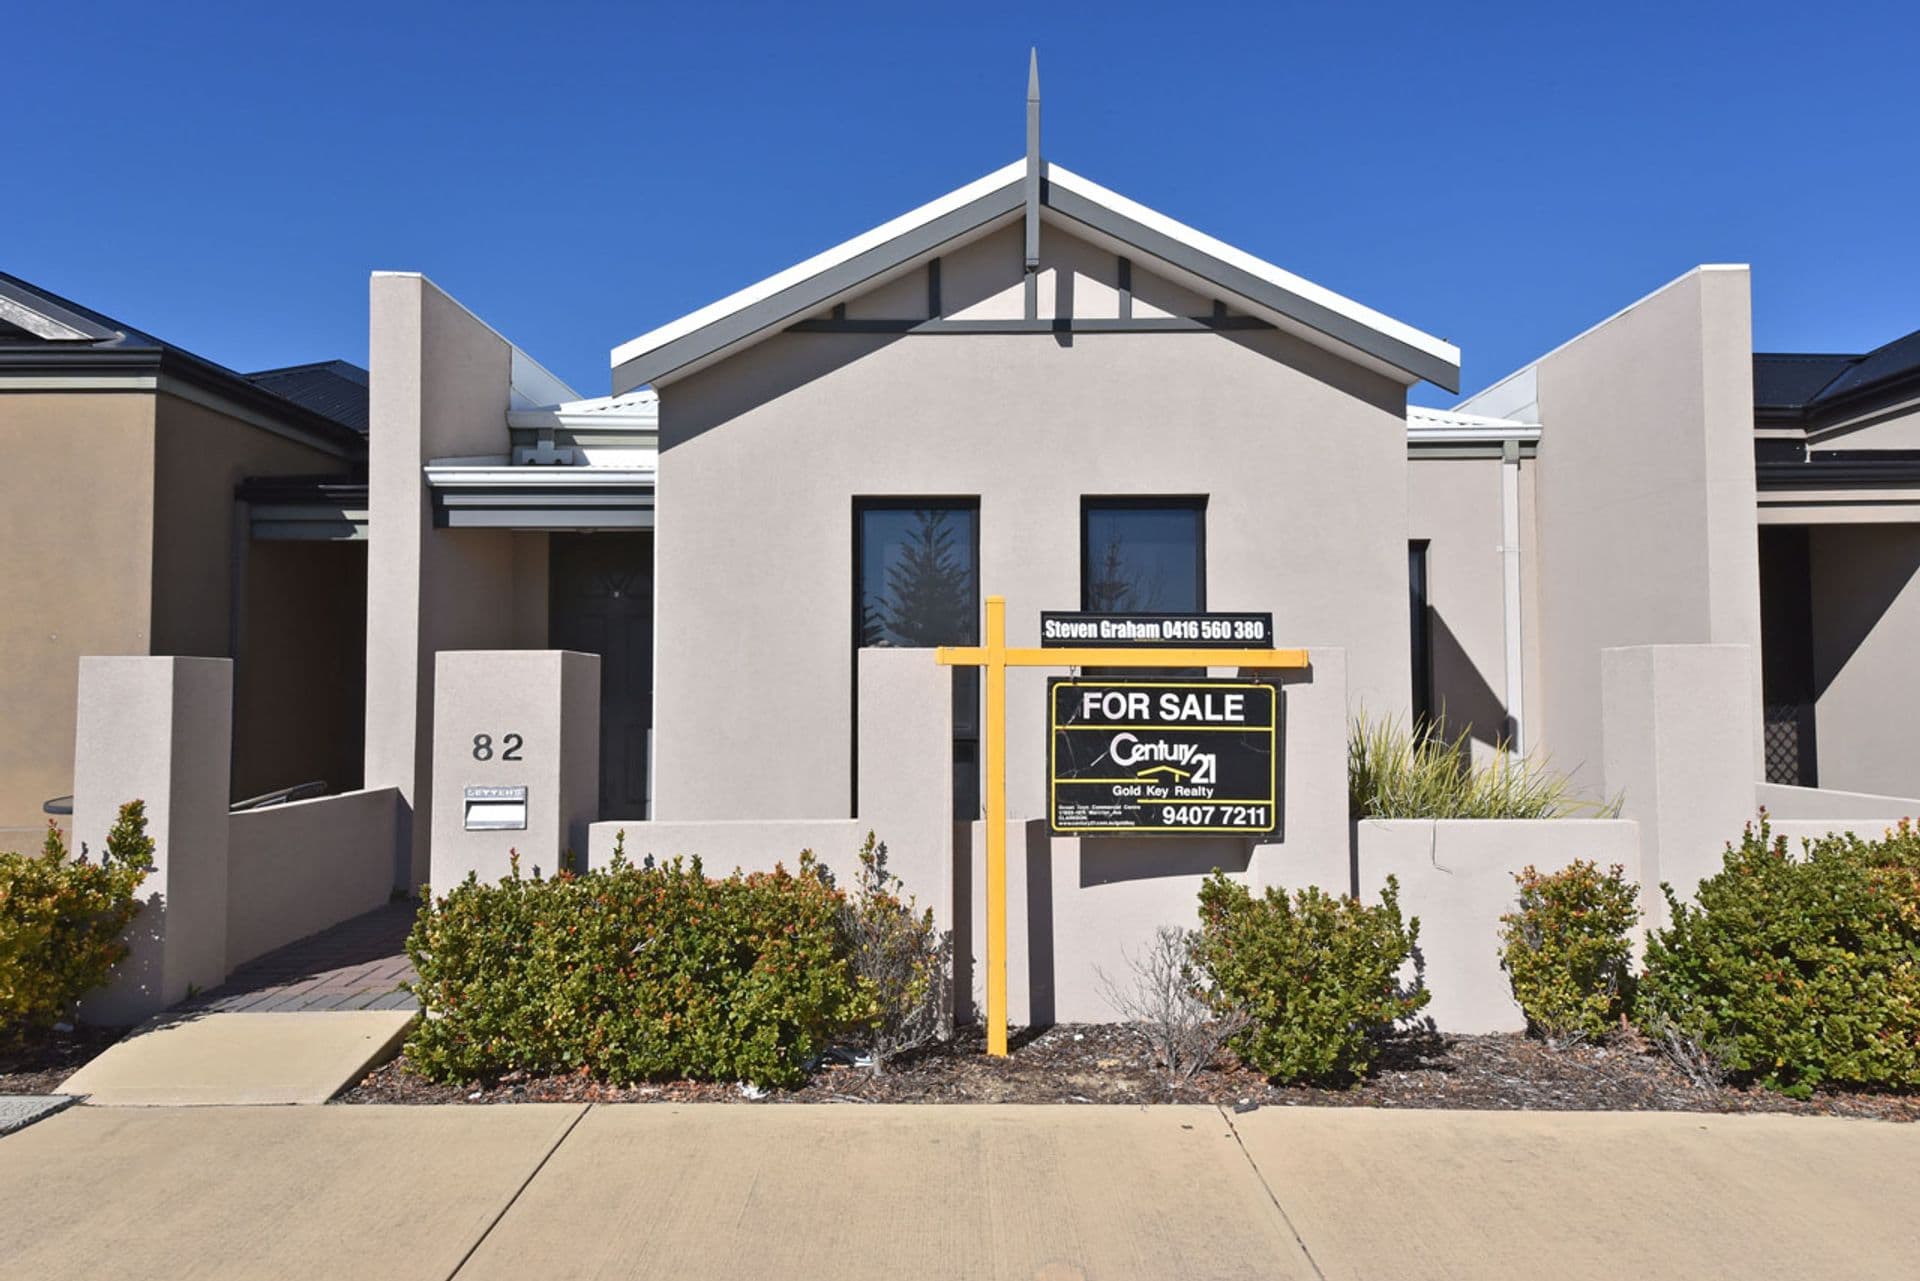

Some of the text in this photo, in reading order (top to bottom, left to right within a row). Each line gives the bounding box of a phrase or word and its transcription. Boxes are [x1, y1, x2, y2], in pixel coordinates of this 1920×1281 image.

[1045, 620, 1264, 640] Steven Graham 0416 560 380
[1083, 692, 1245, 721] FOR SALE
[473, 733, 523, 761] 82
[1110, 732, 1198, 766] Century
[1190, 754, 1216, 784] 21
[1112, 785, 1214, 799] Gold Key Realty
[1162, 806, 1265, 826] 9407 7211
